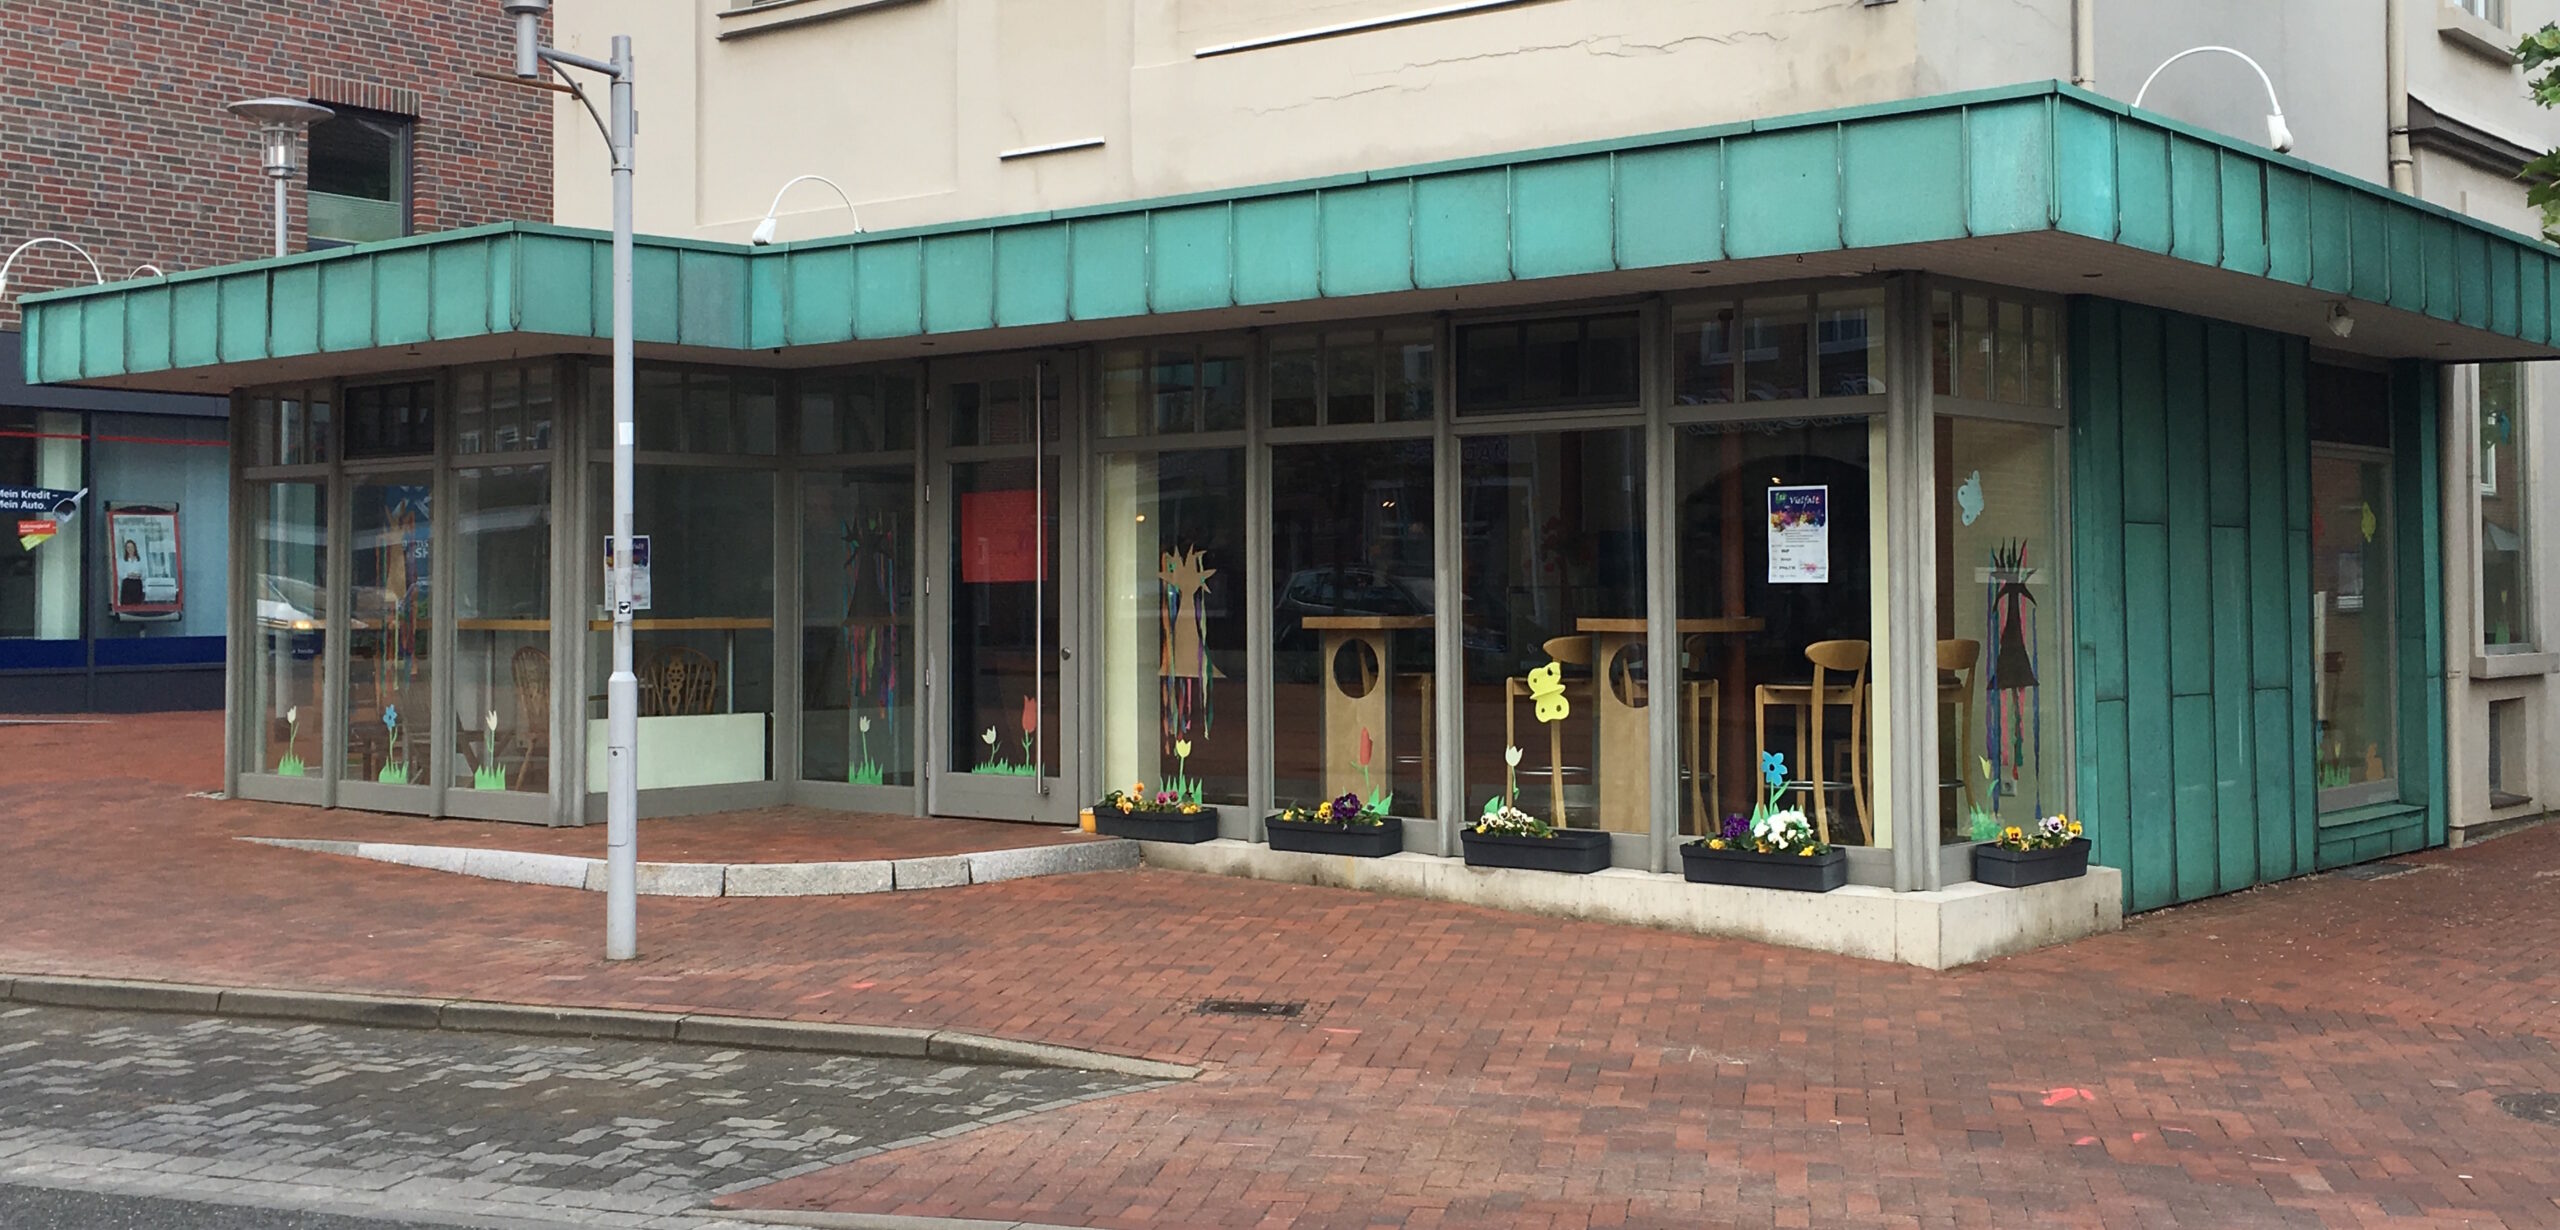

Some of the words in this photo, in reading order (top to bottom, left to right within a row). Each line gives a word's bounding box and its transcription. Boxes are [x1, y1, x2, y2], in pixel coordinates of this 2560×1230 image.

[21, 489, 50, 499] Kredit
[21, 500, 47, 509] Auto.
[1790, 495, 1820, 508] Vielfalt
